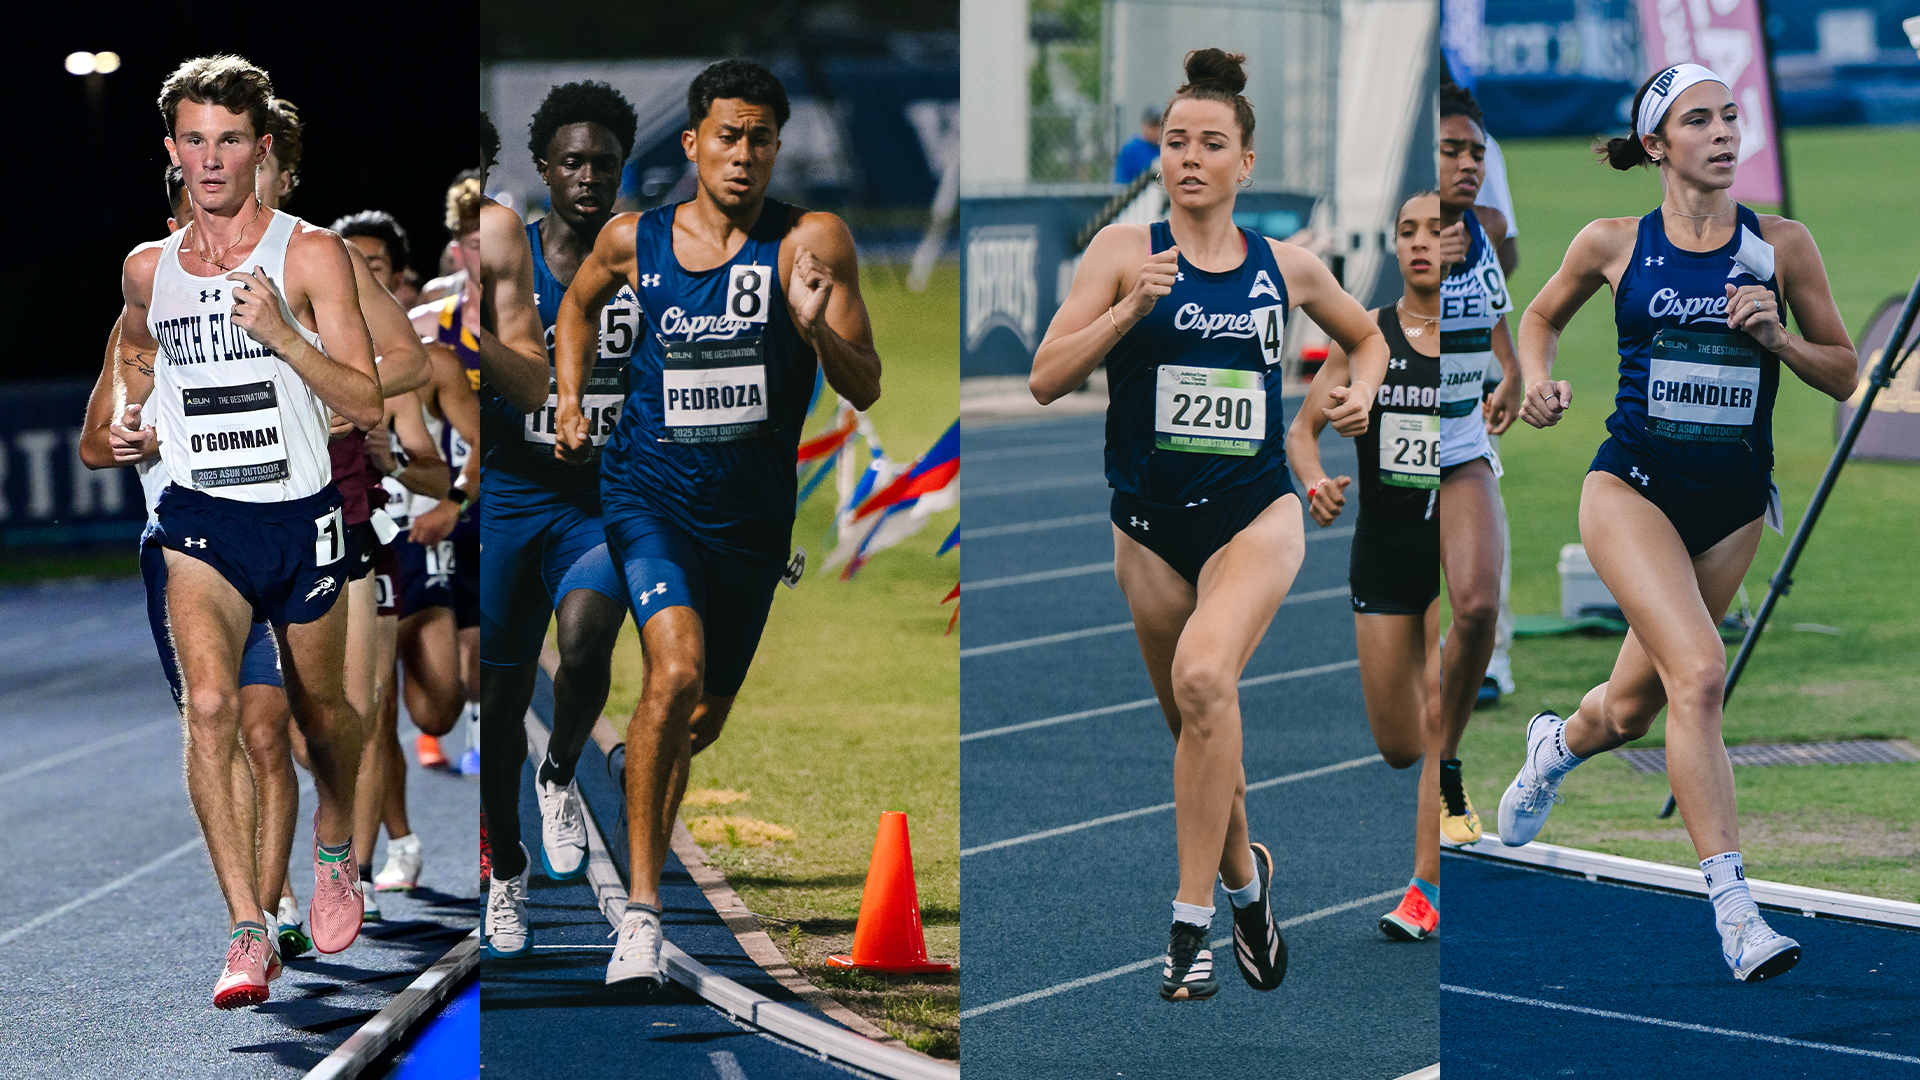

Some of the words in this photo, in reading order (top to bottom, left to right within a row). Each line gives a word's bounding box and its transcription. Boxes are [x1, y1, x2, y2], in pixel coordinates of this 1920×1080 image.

[731, 270, 761, 318] 8
[1482, 267, 1507, 310] 9
[1648, 287, 1727, 325] Ospre
[605, 308, 633, 355] 5
[1173, 302, 1259, 339] Osprey
[1264, 309, 1280, 359] 4
[666, 351, 693, 360] ASUN
[701, 351, 714, 360] THE
[714, 348, 757, 360] DESTINATION.
[1656, 340, 1688, 350] ASUN
[1697, 344, 1711, 354] THE
[1712, 345, 1755, 357] DESTINATION.
[587, 377, 619, 386] STINATION.
[1651, 379, 1754, 409] CHANDLER
[186, 397, 210, 406] ASUN
[218, 396, 230, 405] THE
[230, 391, 271, 404] DESTINATION.
[667, 384, 763, 411] PEDROZA
[532, 405, 617, 437] TEIS
[1171, 393, 1253, 431] 2290
[190, 426, 279, 453] O'GORMAN
[672, 428, 692, 438] 2025
[695, 427, 717, 437] ASUN
[1656, 420, 1677, 433] 2025
[1678, 423, 1702, 435] ASUN
[1703, 426, 1742, 437] OUTDOOR
[1656, 430, 1672, 438] TRACK
[1672, 432, 1684, 440] AND
[1684, 434, 1699, 442] FIELD
[1170, 436, 1251, 450] WWW.ADKINSTRAK.COM
[198, 470, 217, 481] 2025
[219, 467, 240, 478] ASUN
[242, 463, 280, 477] OUTDOOR
[323, 518, 338, 561] 1
